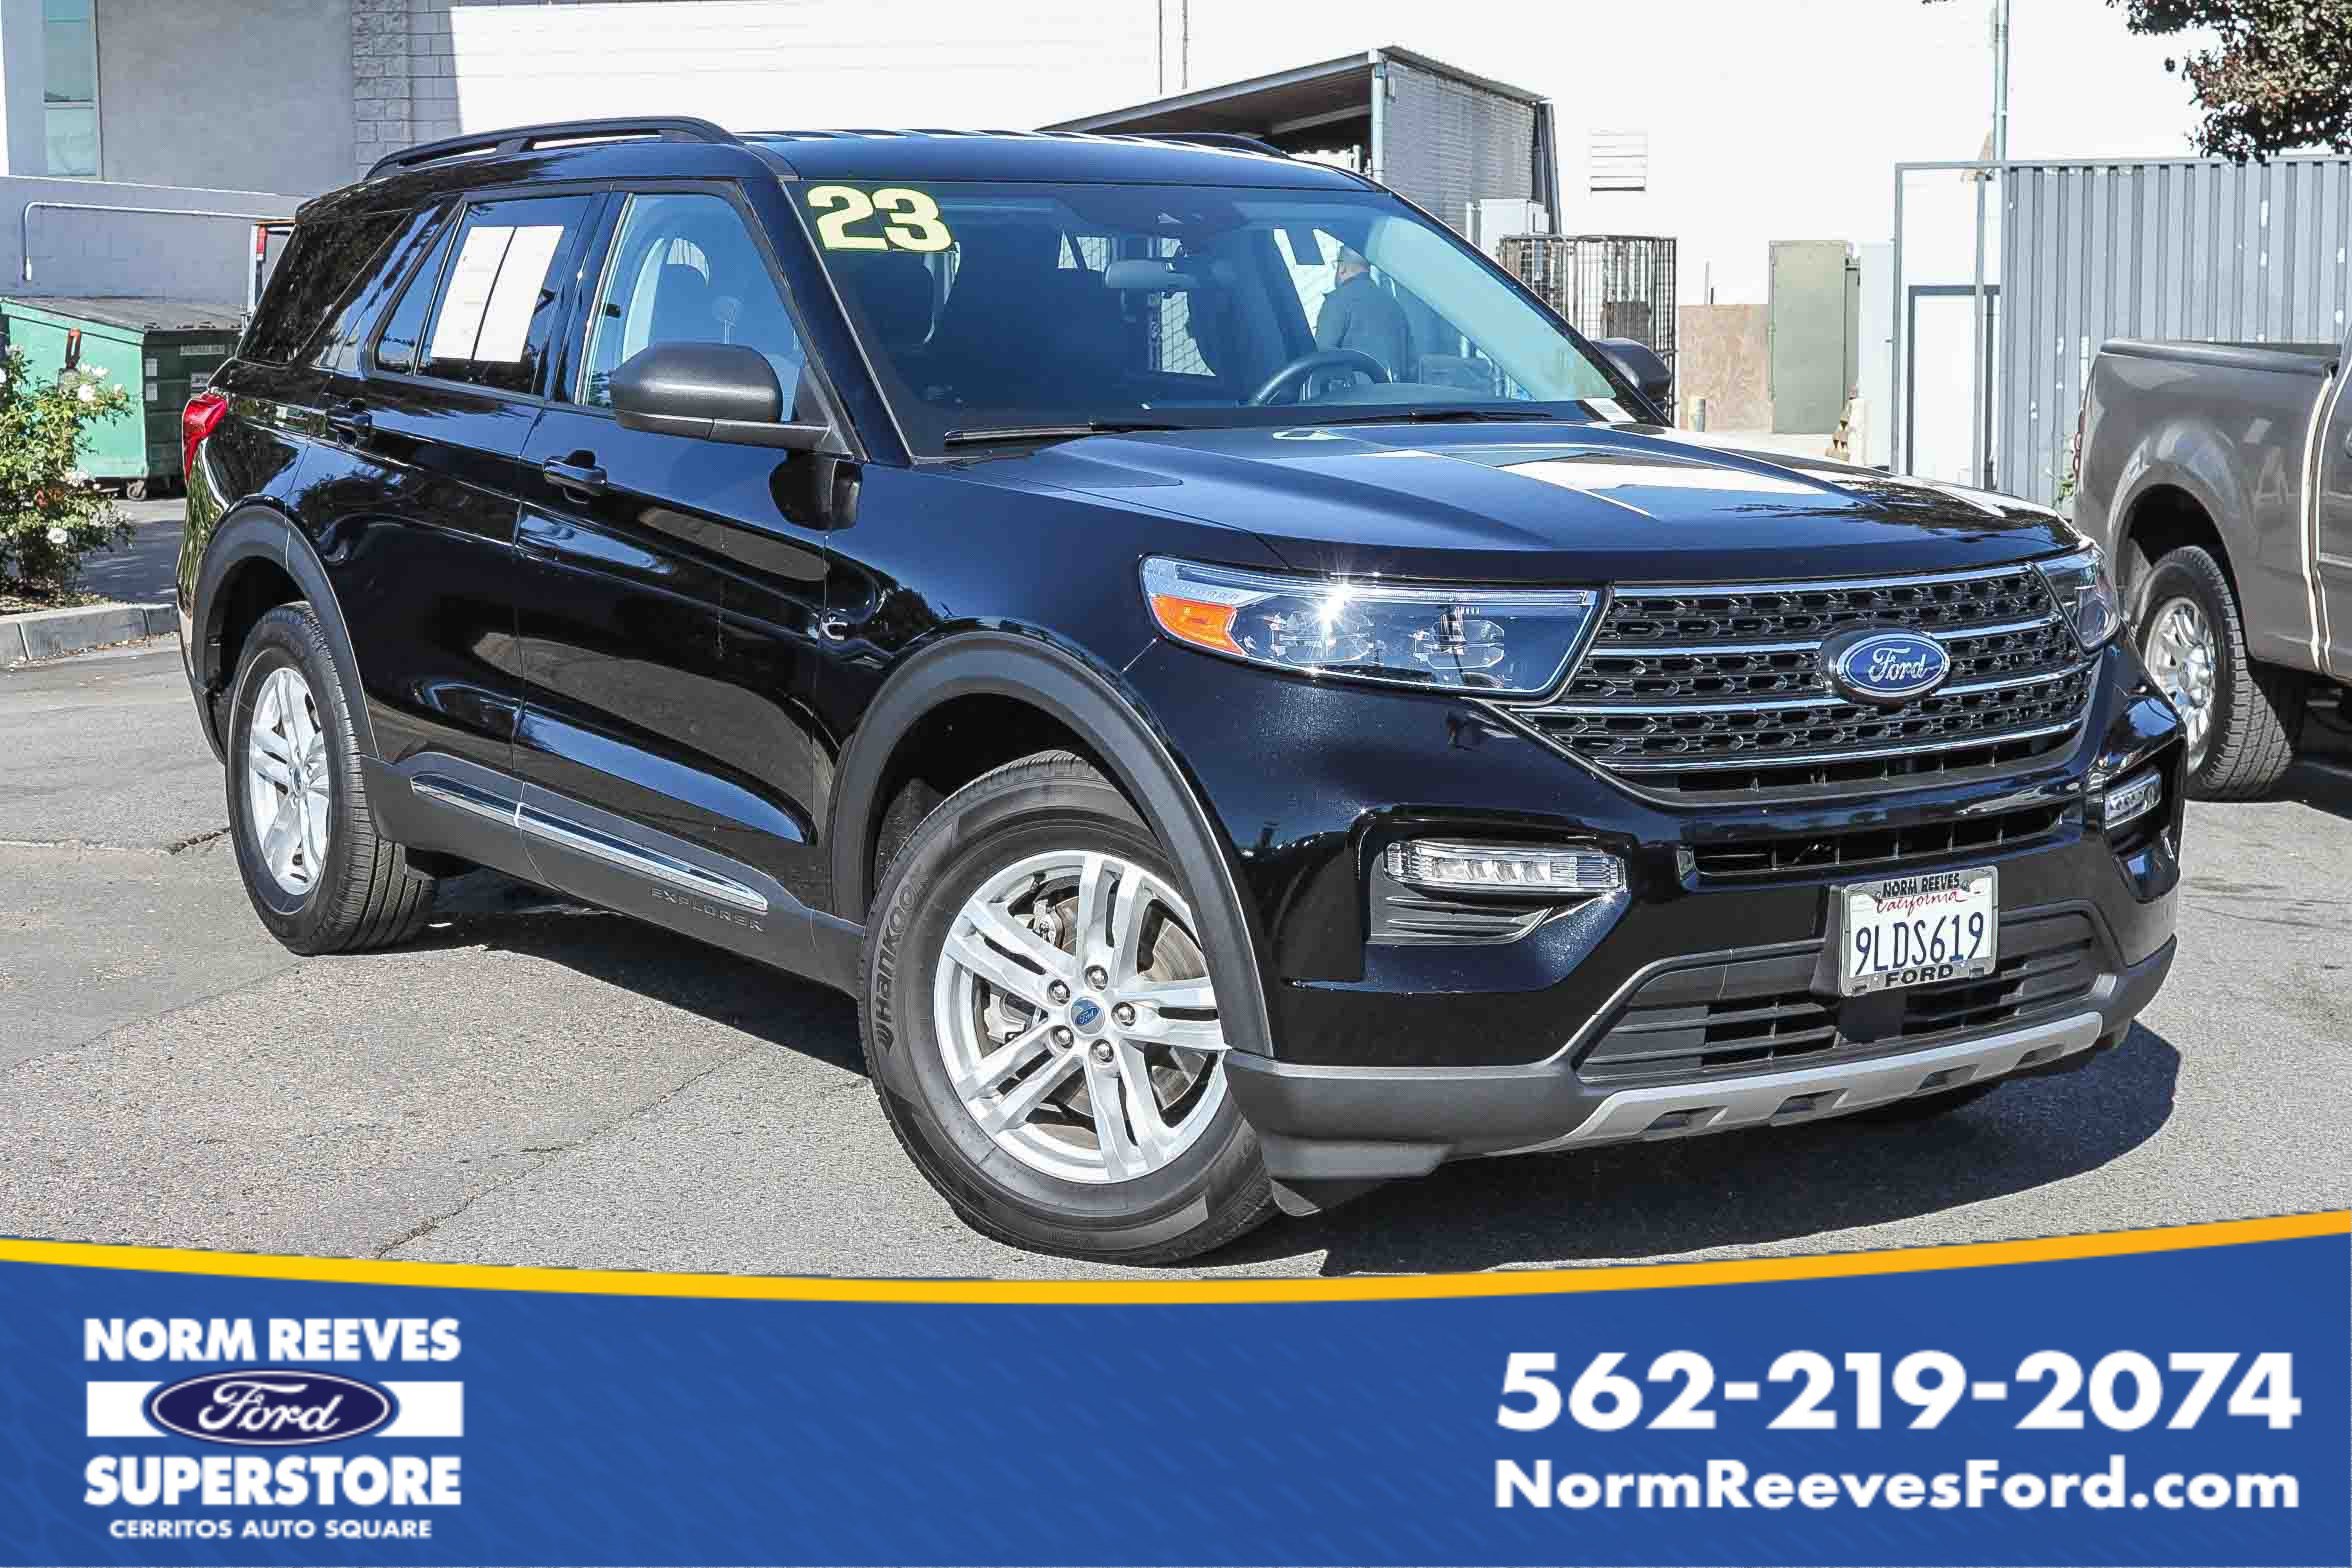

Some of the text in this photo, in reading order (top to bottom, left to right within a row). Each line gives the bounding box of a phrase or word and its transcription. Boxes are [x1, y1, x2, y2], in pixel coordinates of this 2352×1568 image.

[807, 185, 952, 252] 23
[1868, 647, 1929, 683] Ford
[1874, 889, 1968, 917] California
[1882, 872, 1961, 898] NORM REEVES
[651, 887, 764, 933] EXPLORER
[1855, 911, 1984, 976] 9LDS619
[1885, 963, 1954, 988] FORD
